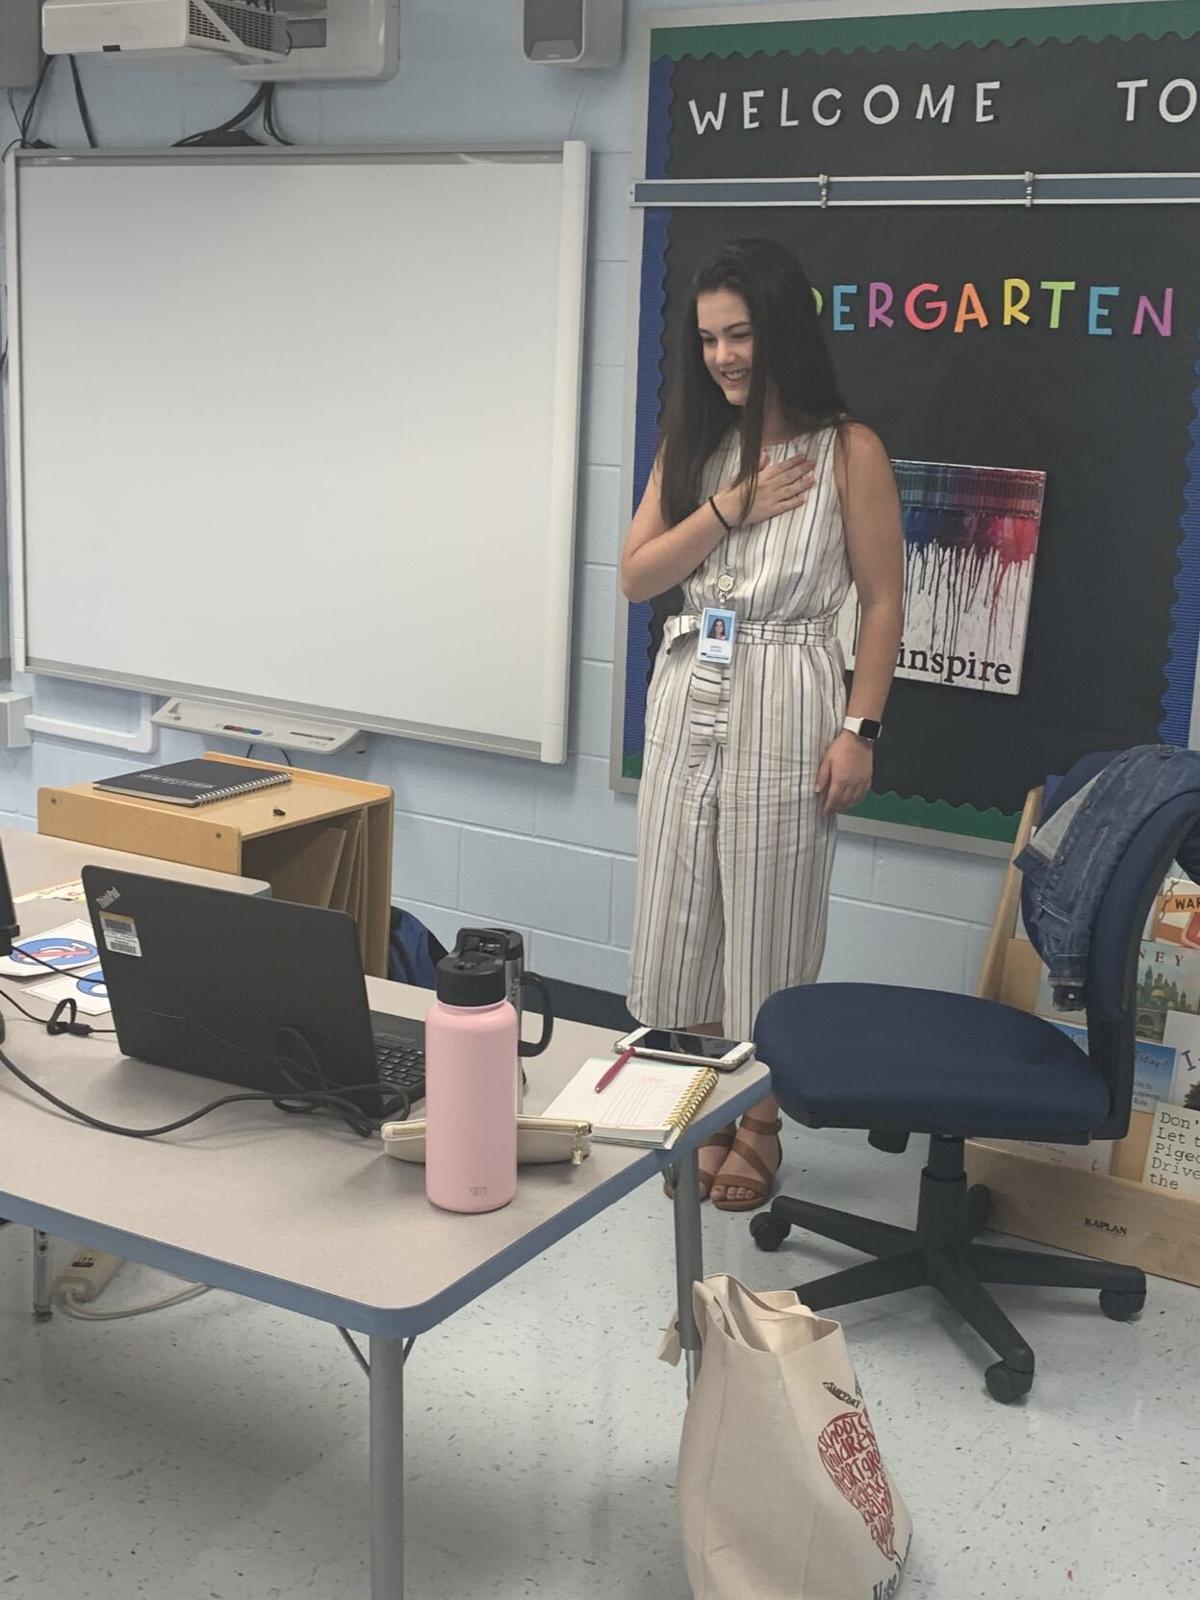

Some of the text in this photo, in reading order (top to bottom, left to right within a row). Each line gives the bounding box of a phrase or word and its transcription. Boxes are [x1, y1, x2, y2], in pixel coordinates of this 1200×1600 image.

[689, 78, 1198, 135] WELCOME TO
[897, 641, 1012, 686] inspire
[1156, 1127, 1187, 1145] Let
[1151, 1156, 1200, 1180] Drive
[1149, 1173, 1179, 1190] the
[1083, 1217, 1128, 1236] KAPLAN
